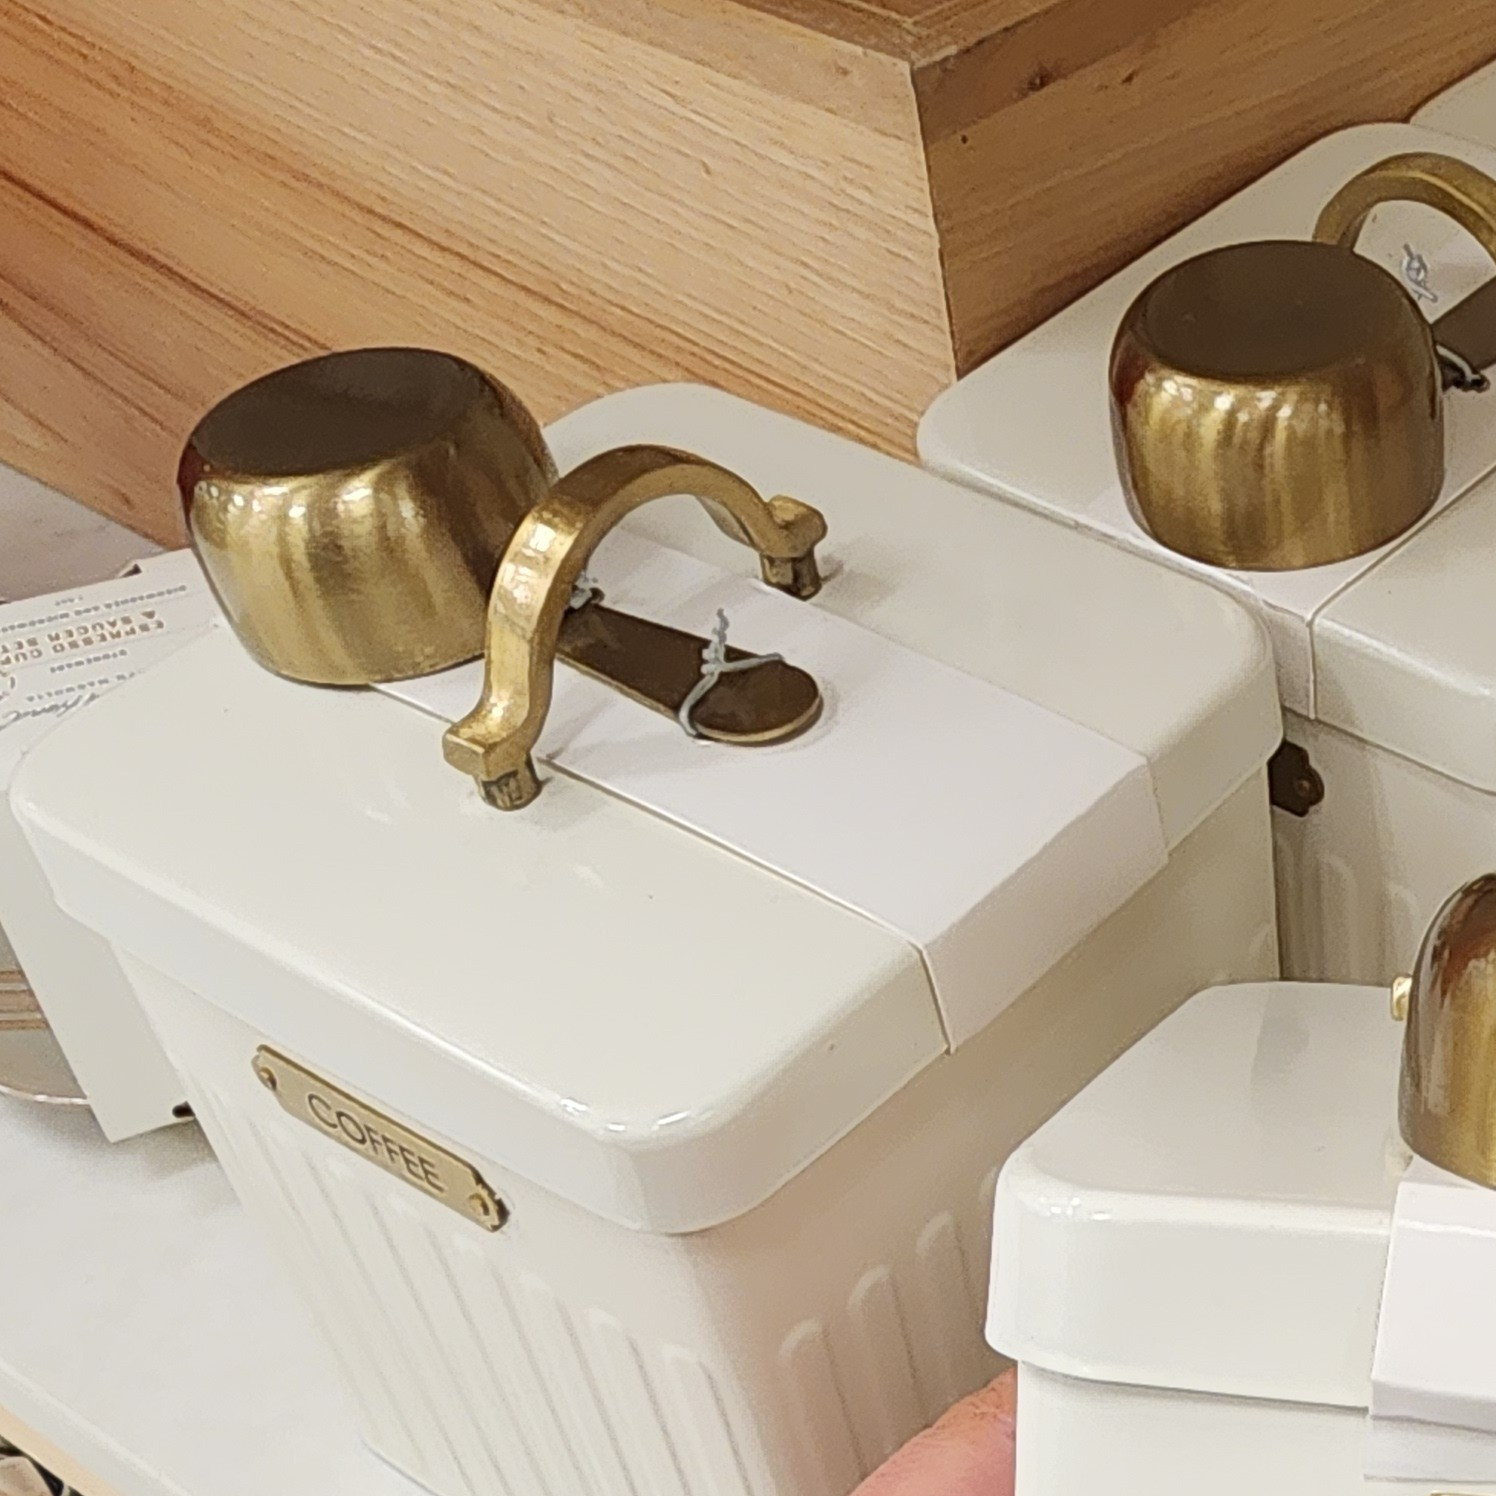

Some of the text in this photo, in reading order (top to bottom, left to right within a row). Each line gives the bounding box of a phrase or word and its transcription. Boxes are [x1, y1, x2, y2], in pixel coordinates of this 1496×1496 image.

[0, 620, 164, 665] ESPRESSO CUP
[47, 616, 133, 642] SAUCER
[308, 1094, 445, 1193] COFFEE
